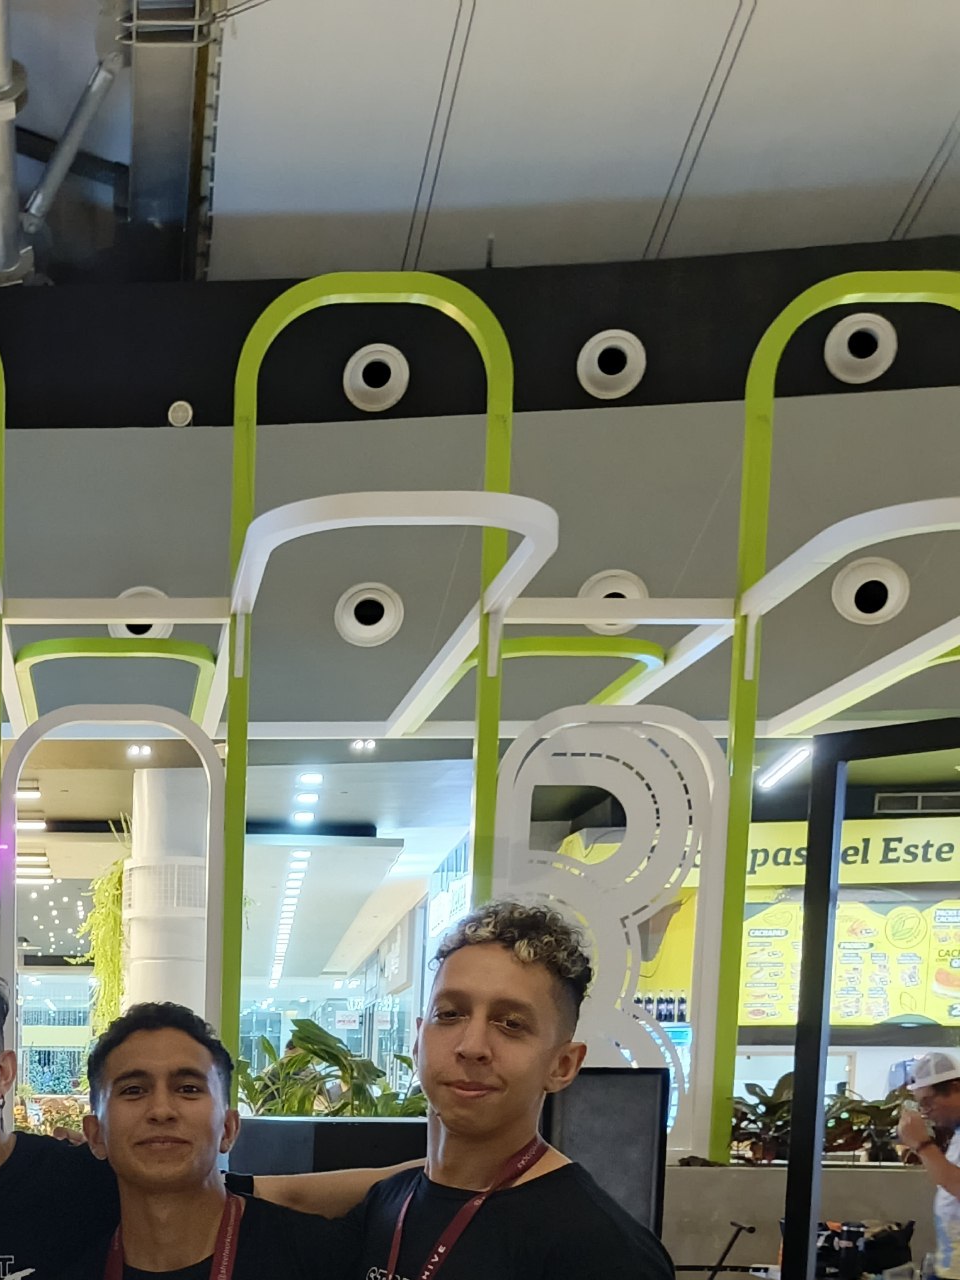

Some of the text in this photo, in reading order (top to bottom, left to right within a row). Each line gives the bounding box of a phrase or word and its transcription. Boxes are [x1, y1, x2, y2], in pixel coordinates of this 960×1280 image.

[747, 837, 955, 875] pas el Este
[421, 1245, 446, 1280] HIVE
